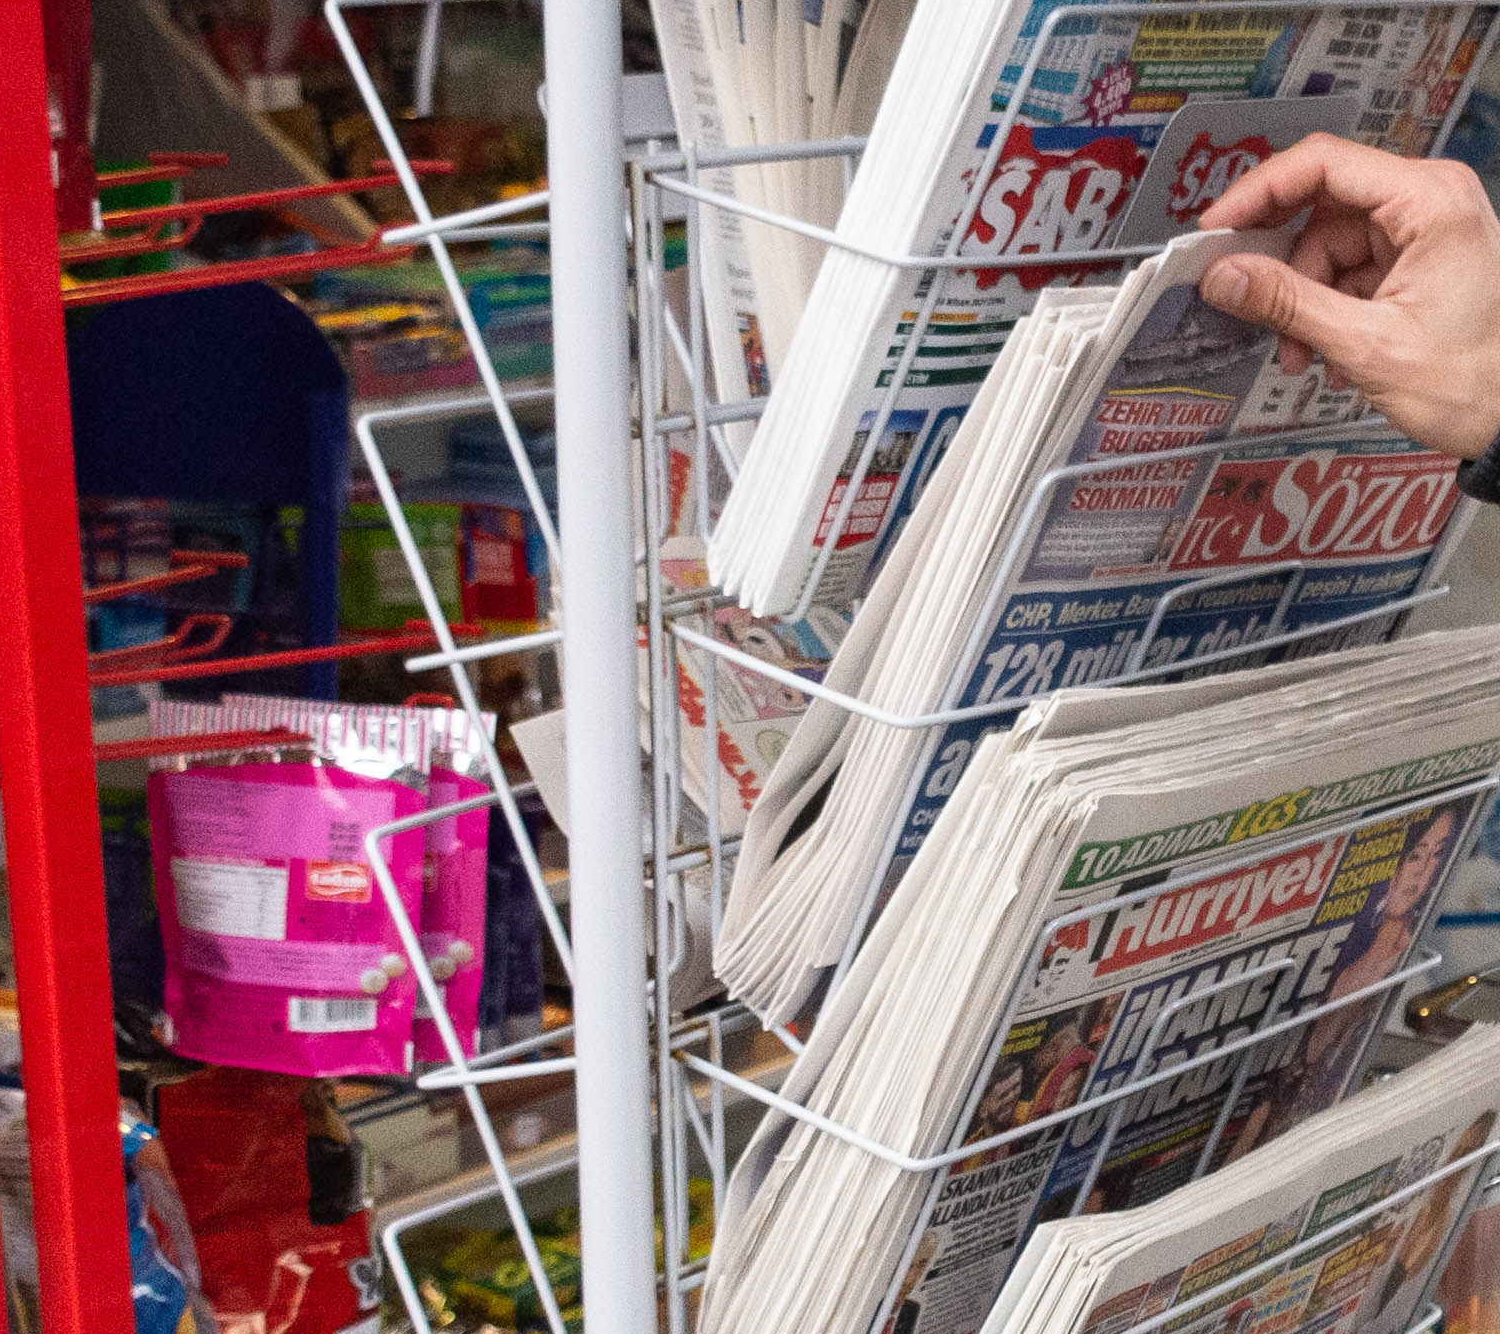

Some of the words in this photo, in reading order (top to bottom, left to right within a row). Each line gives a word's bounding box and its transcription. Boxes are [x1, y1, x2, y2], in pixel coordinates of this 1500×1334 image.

[1005, 600, 1055, 632] CHP,
[971, 639, 1067, 704] 128
[1061, 628, 1190, 689] milar
[1075, 841, 1121, 886] 10
[1120, 812, 1233, 871] ADIMDA
[1228, 786, 1313, 845] LGS
[1299, 758, 1417, 817] HAZIRLIK
